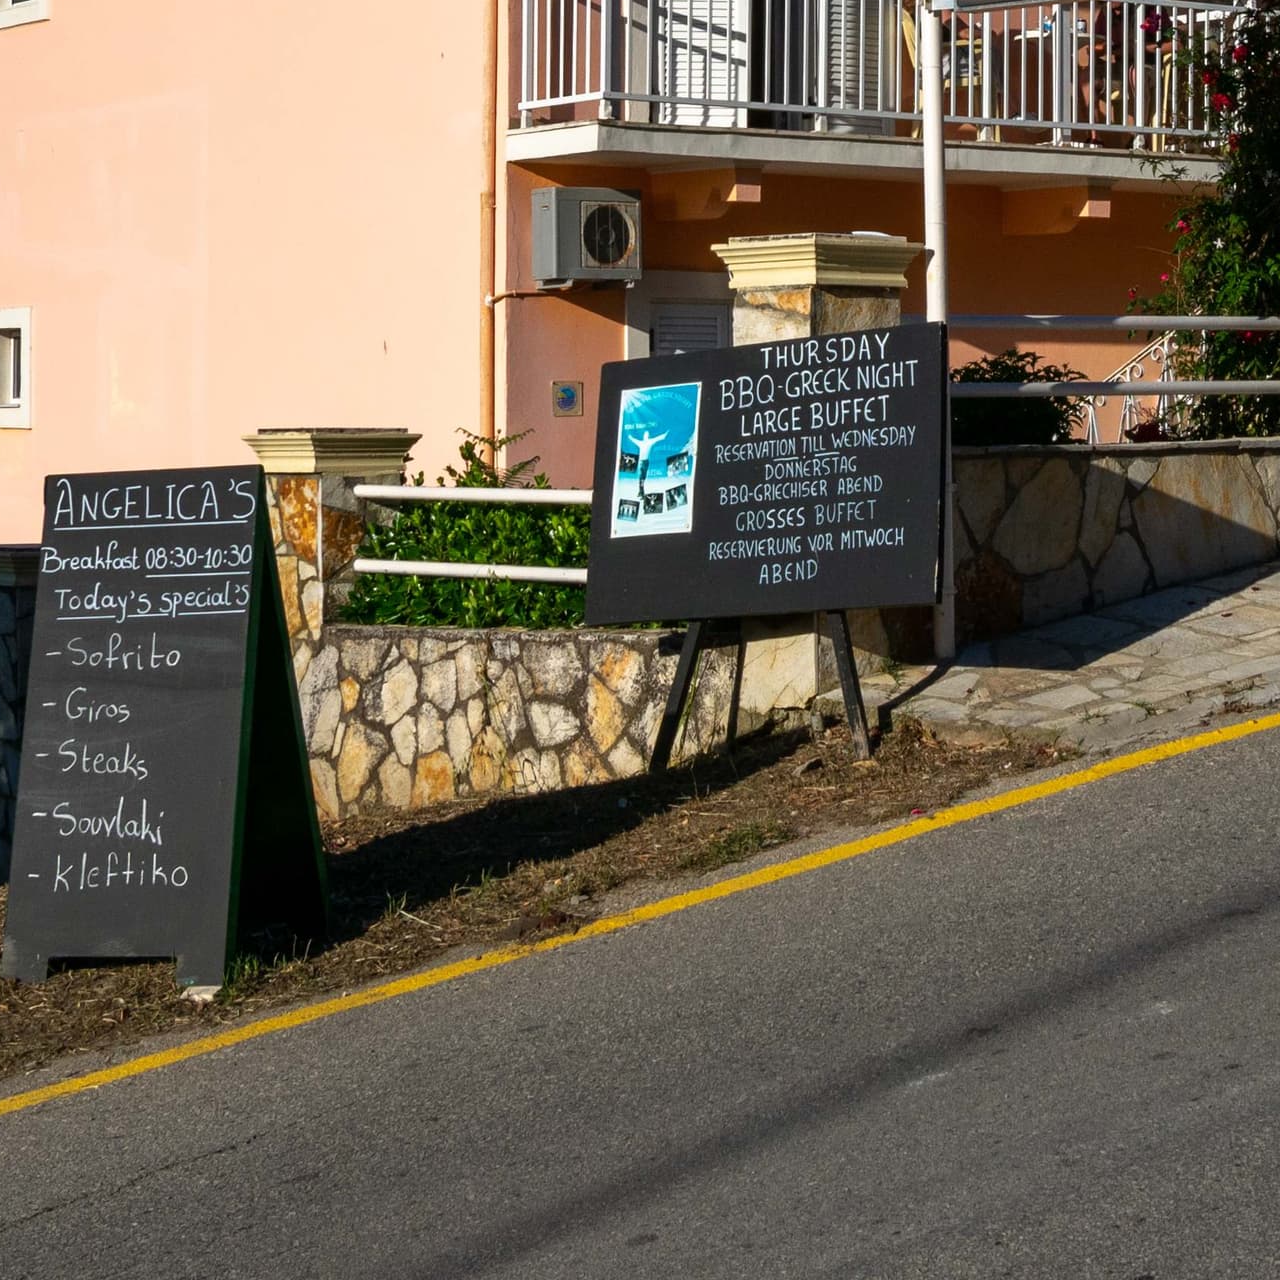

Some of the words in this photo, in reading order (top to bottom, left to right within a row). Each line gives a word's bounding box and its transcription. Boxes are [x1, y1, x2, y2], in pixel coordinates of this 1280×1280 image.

[760, 332, 890, 369] THURSDAY
[720, 367, 850, 411] BBQ-GREEK
[857, 360, 919, 390] NIGHT
[741, 406, 801, 437] LARGE
[811, 395, 890, 429] BUFFET
[715, 437, 796, 464] RESERVATION
[801, 436, 826, 454] TILL
[832, 425, 916, 449] WEDNESDAY
[765, 456, 857, 481] DONNERSTAG
[53, 478, 256, 526] ANGELICA'S
[718, 479, 828, 506] BBQ-GRIECHISER
[837, 475, 883, 495] ABEND
[735, 506, 806, 532] GROSSES
[815, 500, 877, 526] BUFFET
[40, 540, 140, 573] Breakfast
[145, 544, 253, 570] 08:30-10:30
[709, 535, 802, 561] RESERVIERUNG
[808, 532, 834, 552] VOR
[840, 527, 904, 550] MITWOCH
[759, 559, 818, 585] ABEND
[54, 582, 152, 623] Today's
[160, 580, 250, 618] special's
[67, 632, 181, 670] Sofrito
[65, 687, 131, 723] Giros
[58, 739, 149, 780] Steaks
[52, 796, 165, 845] Souvlaki
